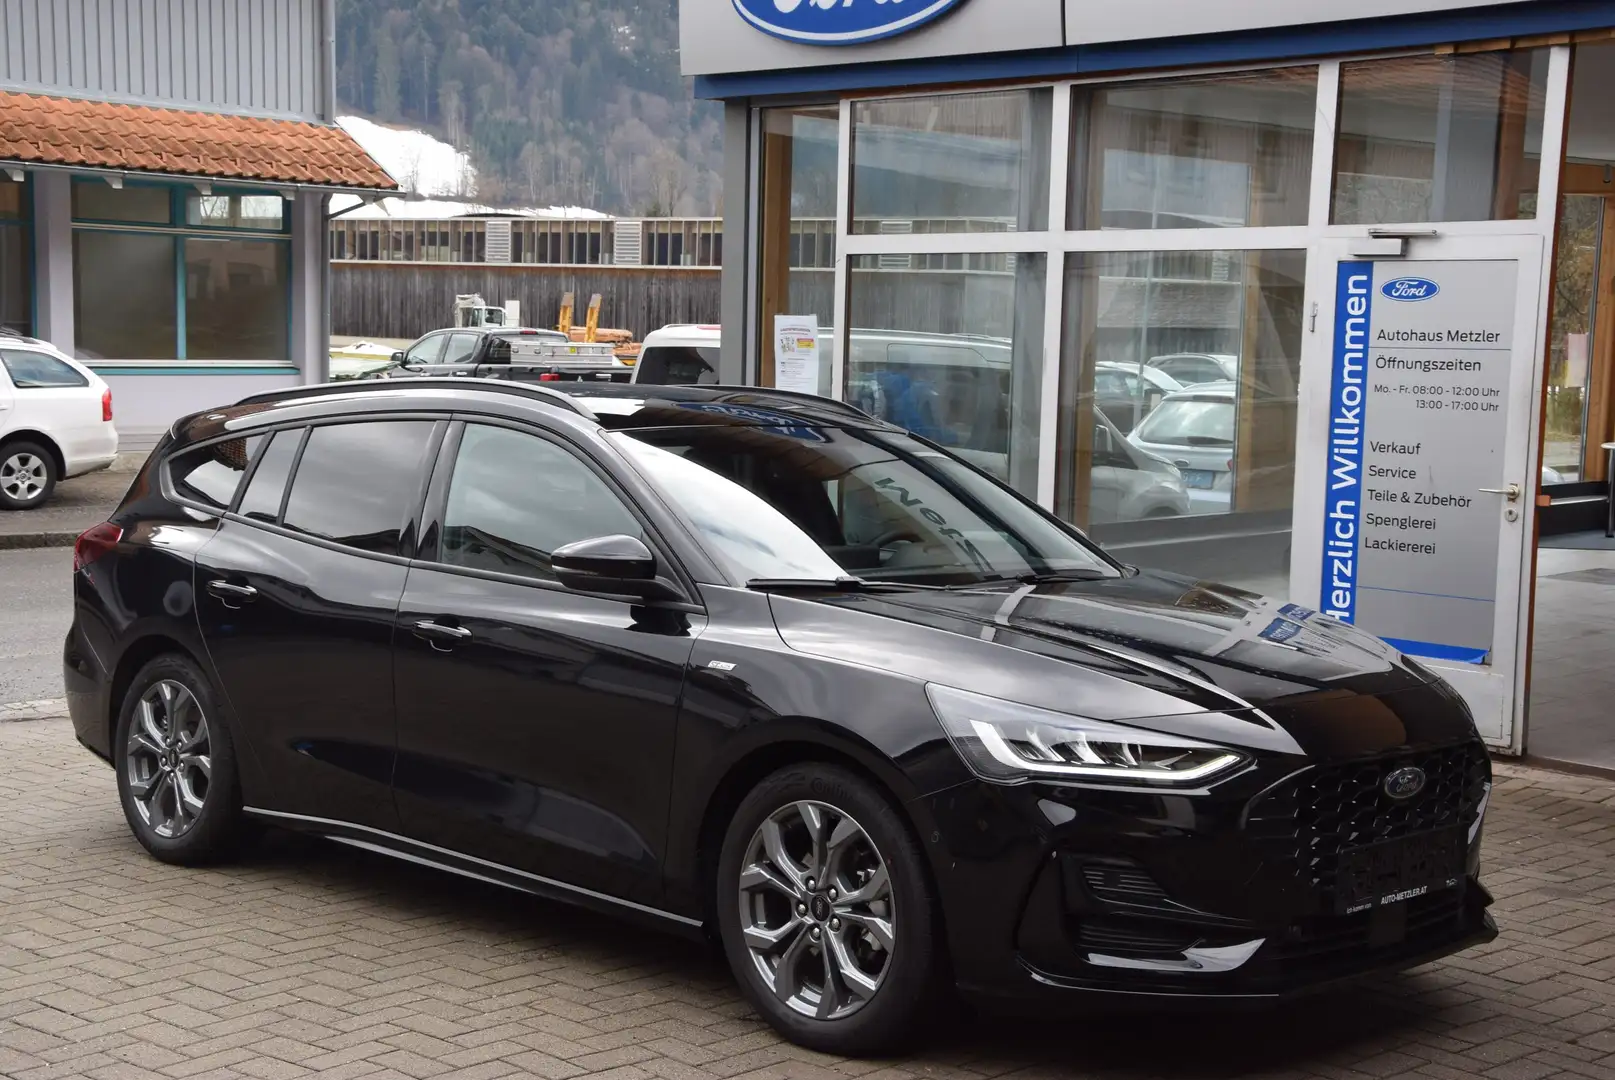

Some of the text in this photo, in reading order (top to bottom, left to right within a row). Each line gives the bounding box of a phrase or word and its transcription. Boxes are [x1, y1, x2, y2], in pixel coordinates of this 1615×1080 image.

[1391, 280, 1427, 297] Ford
[1376, 328, 1501, 343] Autohaus Metzler
[1375, 354, 1482, 373] Öffnungszeiten
[1332, 274, 1368, 490] Willkommen
[1373, 384, 1391, 394] Mo.
[1398, 384, 1411, 394] Fr.
[1412, 385, 1444, 395] 08:00
[1451, 386, 1480, 397] 12:00
[1481, 387, 1501, 397] Uhr
[1415, 399, 1443, 410] 13:00
[1451, 400, 1479, 411] 17:00
[1480, 402, 1500, 412] Uhr
[1369, 440, 1422, 456] Verkauf
[1368, 464, 1417, 480] Service
[1367, 488, 1473, 508] Teile & Zubehör
[1365, 512, 1437, 531] Spenglerei
[1364, 536, 1436, 555] Lackiererei
[1380, 885, 1428, 905] AUTO-METZLER.AT
